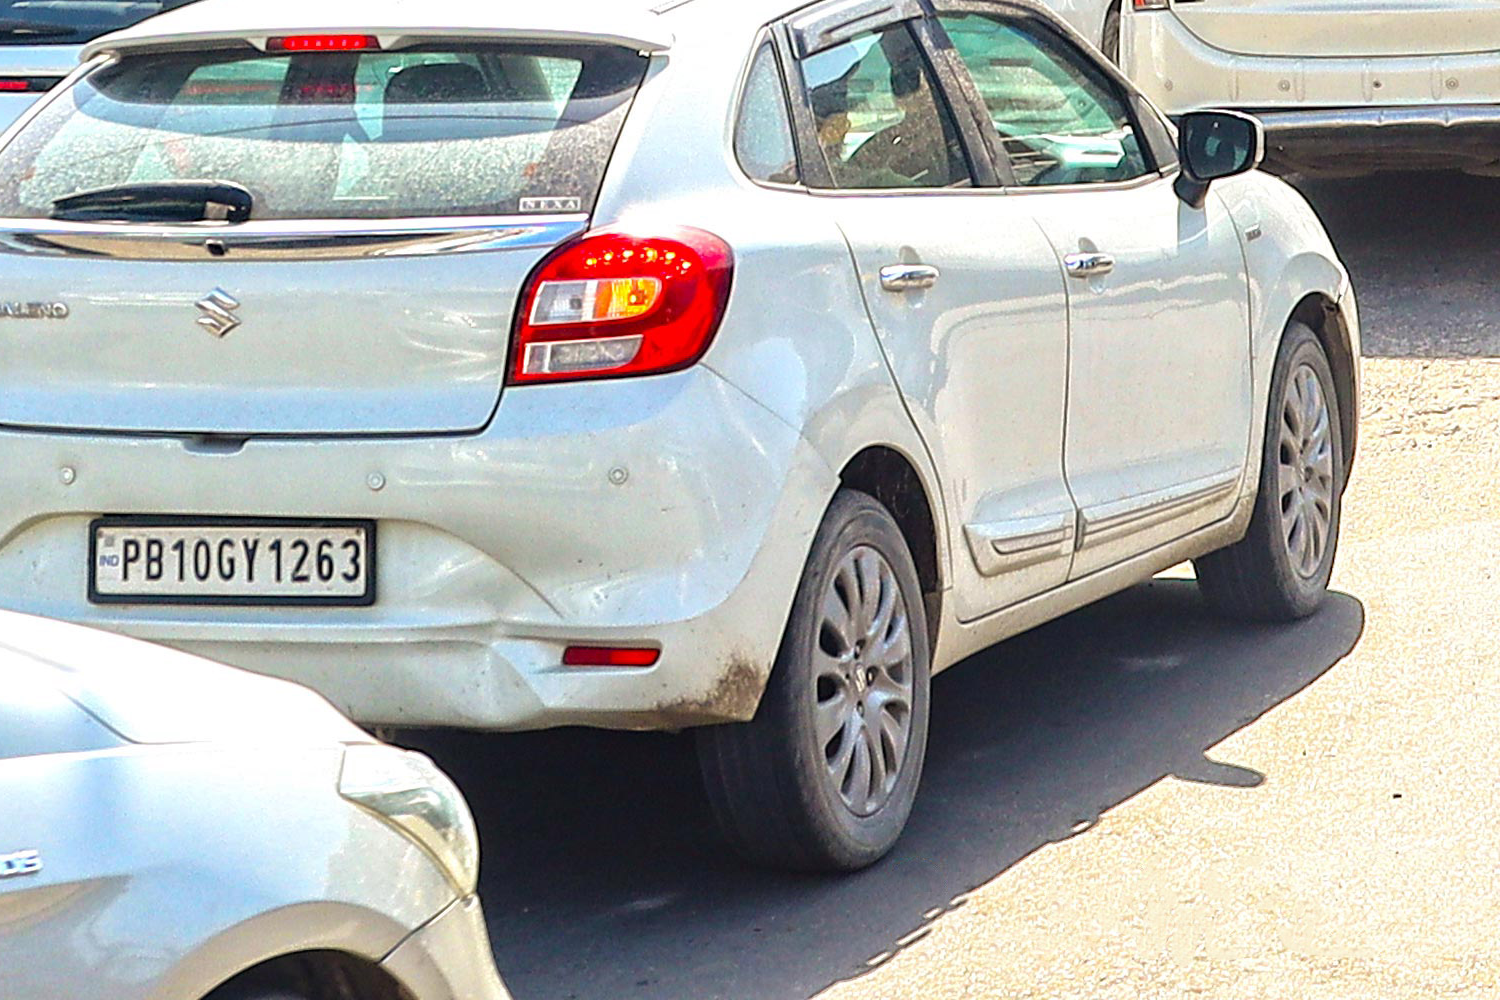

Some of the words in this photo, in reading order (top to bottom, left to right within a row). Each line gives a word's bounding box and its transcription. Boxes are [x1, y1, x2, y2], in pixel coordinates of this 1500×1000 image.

[520, 198, 579, 211] NEXA
[99, 554, 120, 567] IND
[121, 537, 362, 583] PB10GY1263
